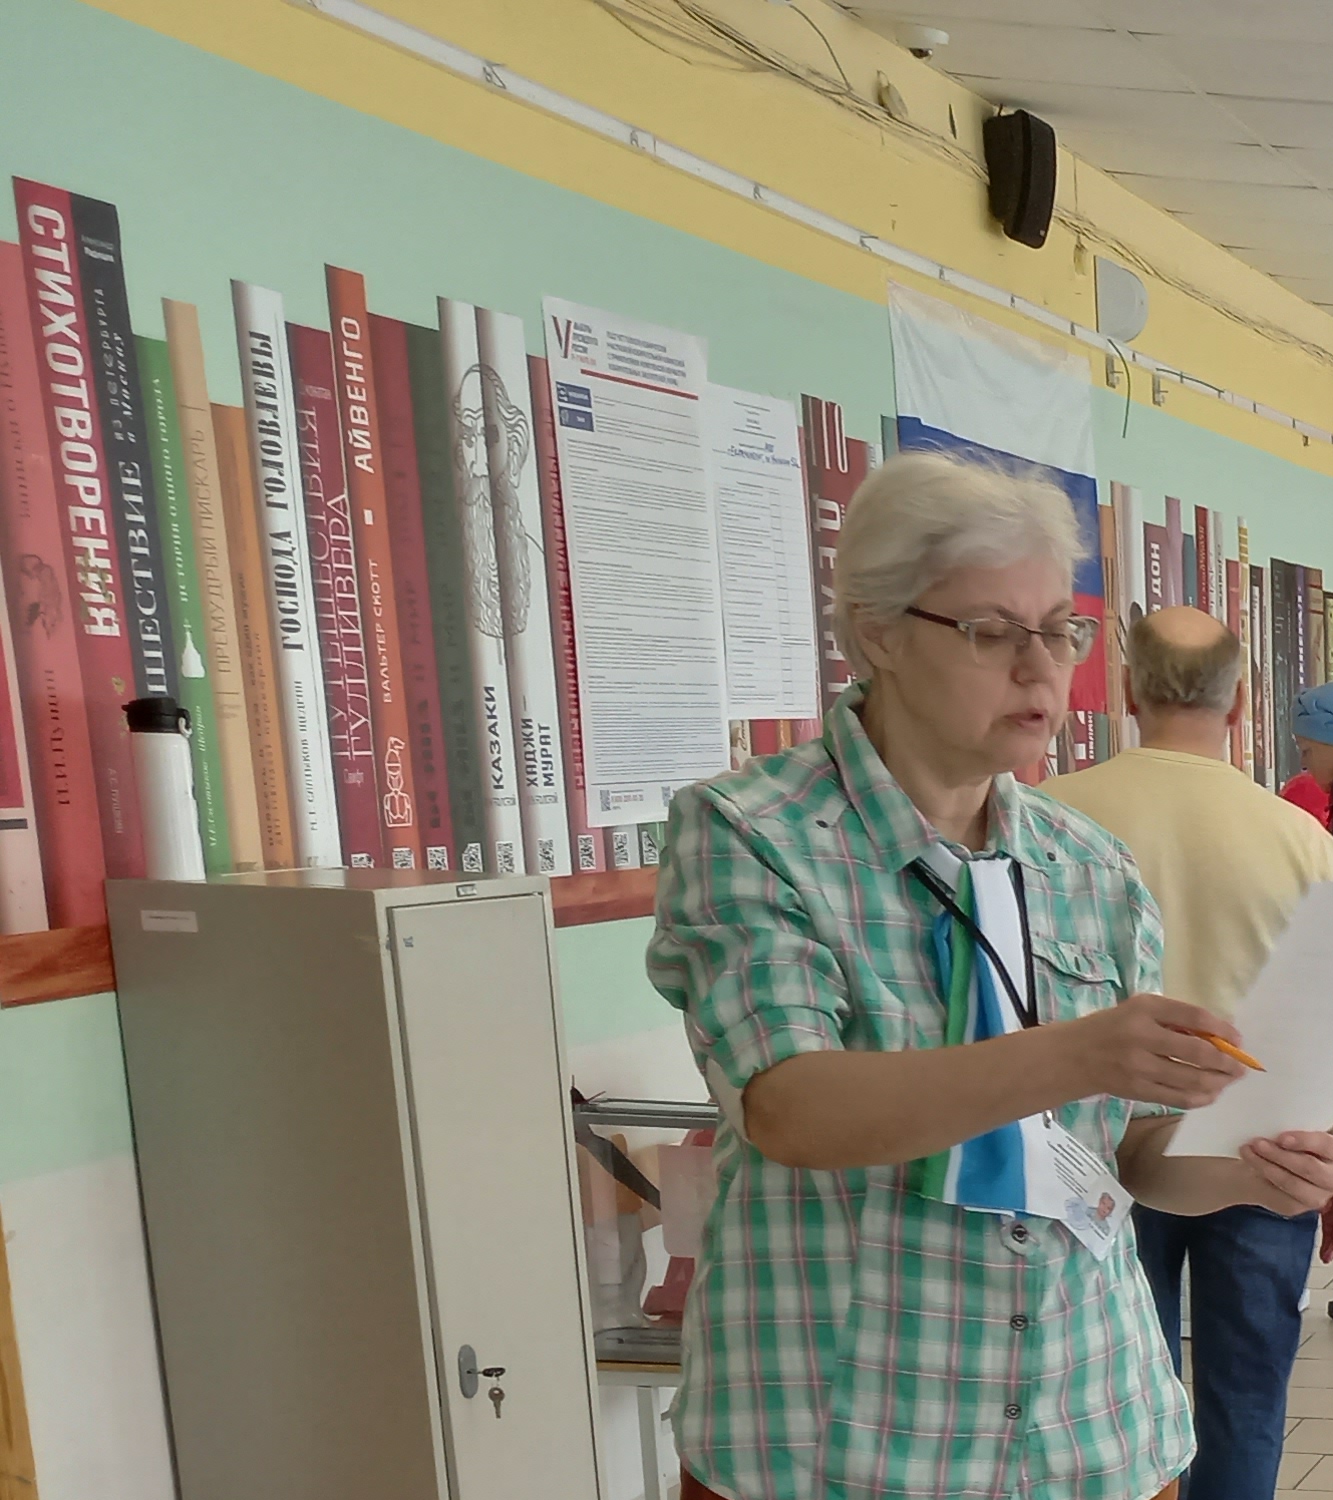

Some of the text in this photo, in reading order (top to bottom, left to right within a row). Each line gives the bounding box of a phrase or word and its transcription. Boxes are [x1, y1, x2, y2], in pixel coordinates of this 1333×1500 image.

[27, 204, 120, 637] СТИХОТВОРЕНИЯ
[249, 330, 304, 650] ГОСПОДА ГОЛОВЛЕВЫ
[340, 316, 375, 474] АЙВЕНГО
[119, 461, 167, 694] ШЕСТВИЕ
[327, 492, 373, 760] ГУЛЛИВЕРА
[375, 622, 393, 704] ВАЛЬТЕР
[483, 686, 505, 790] КАЗАКИ
[537, 722, 555, 787] МУРАТ
